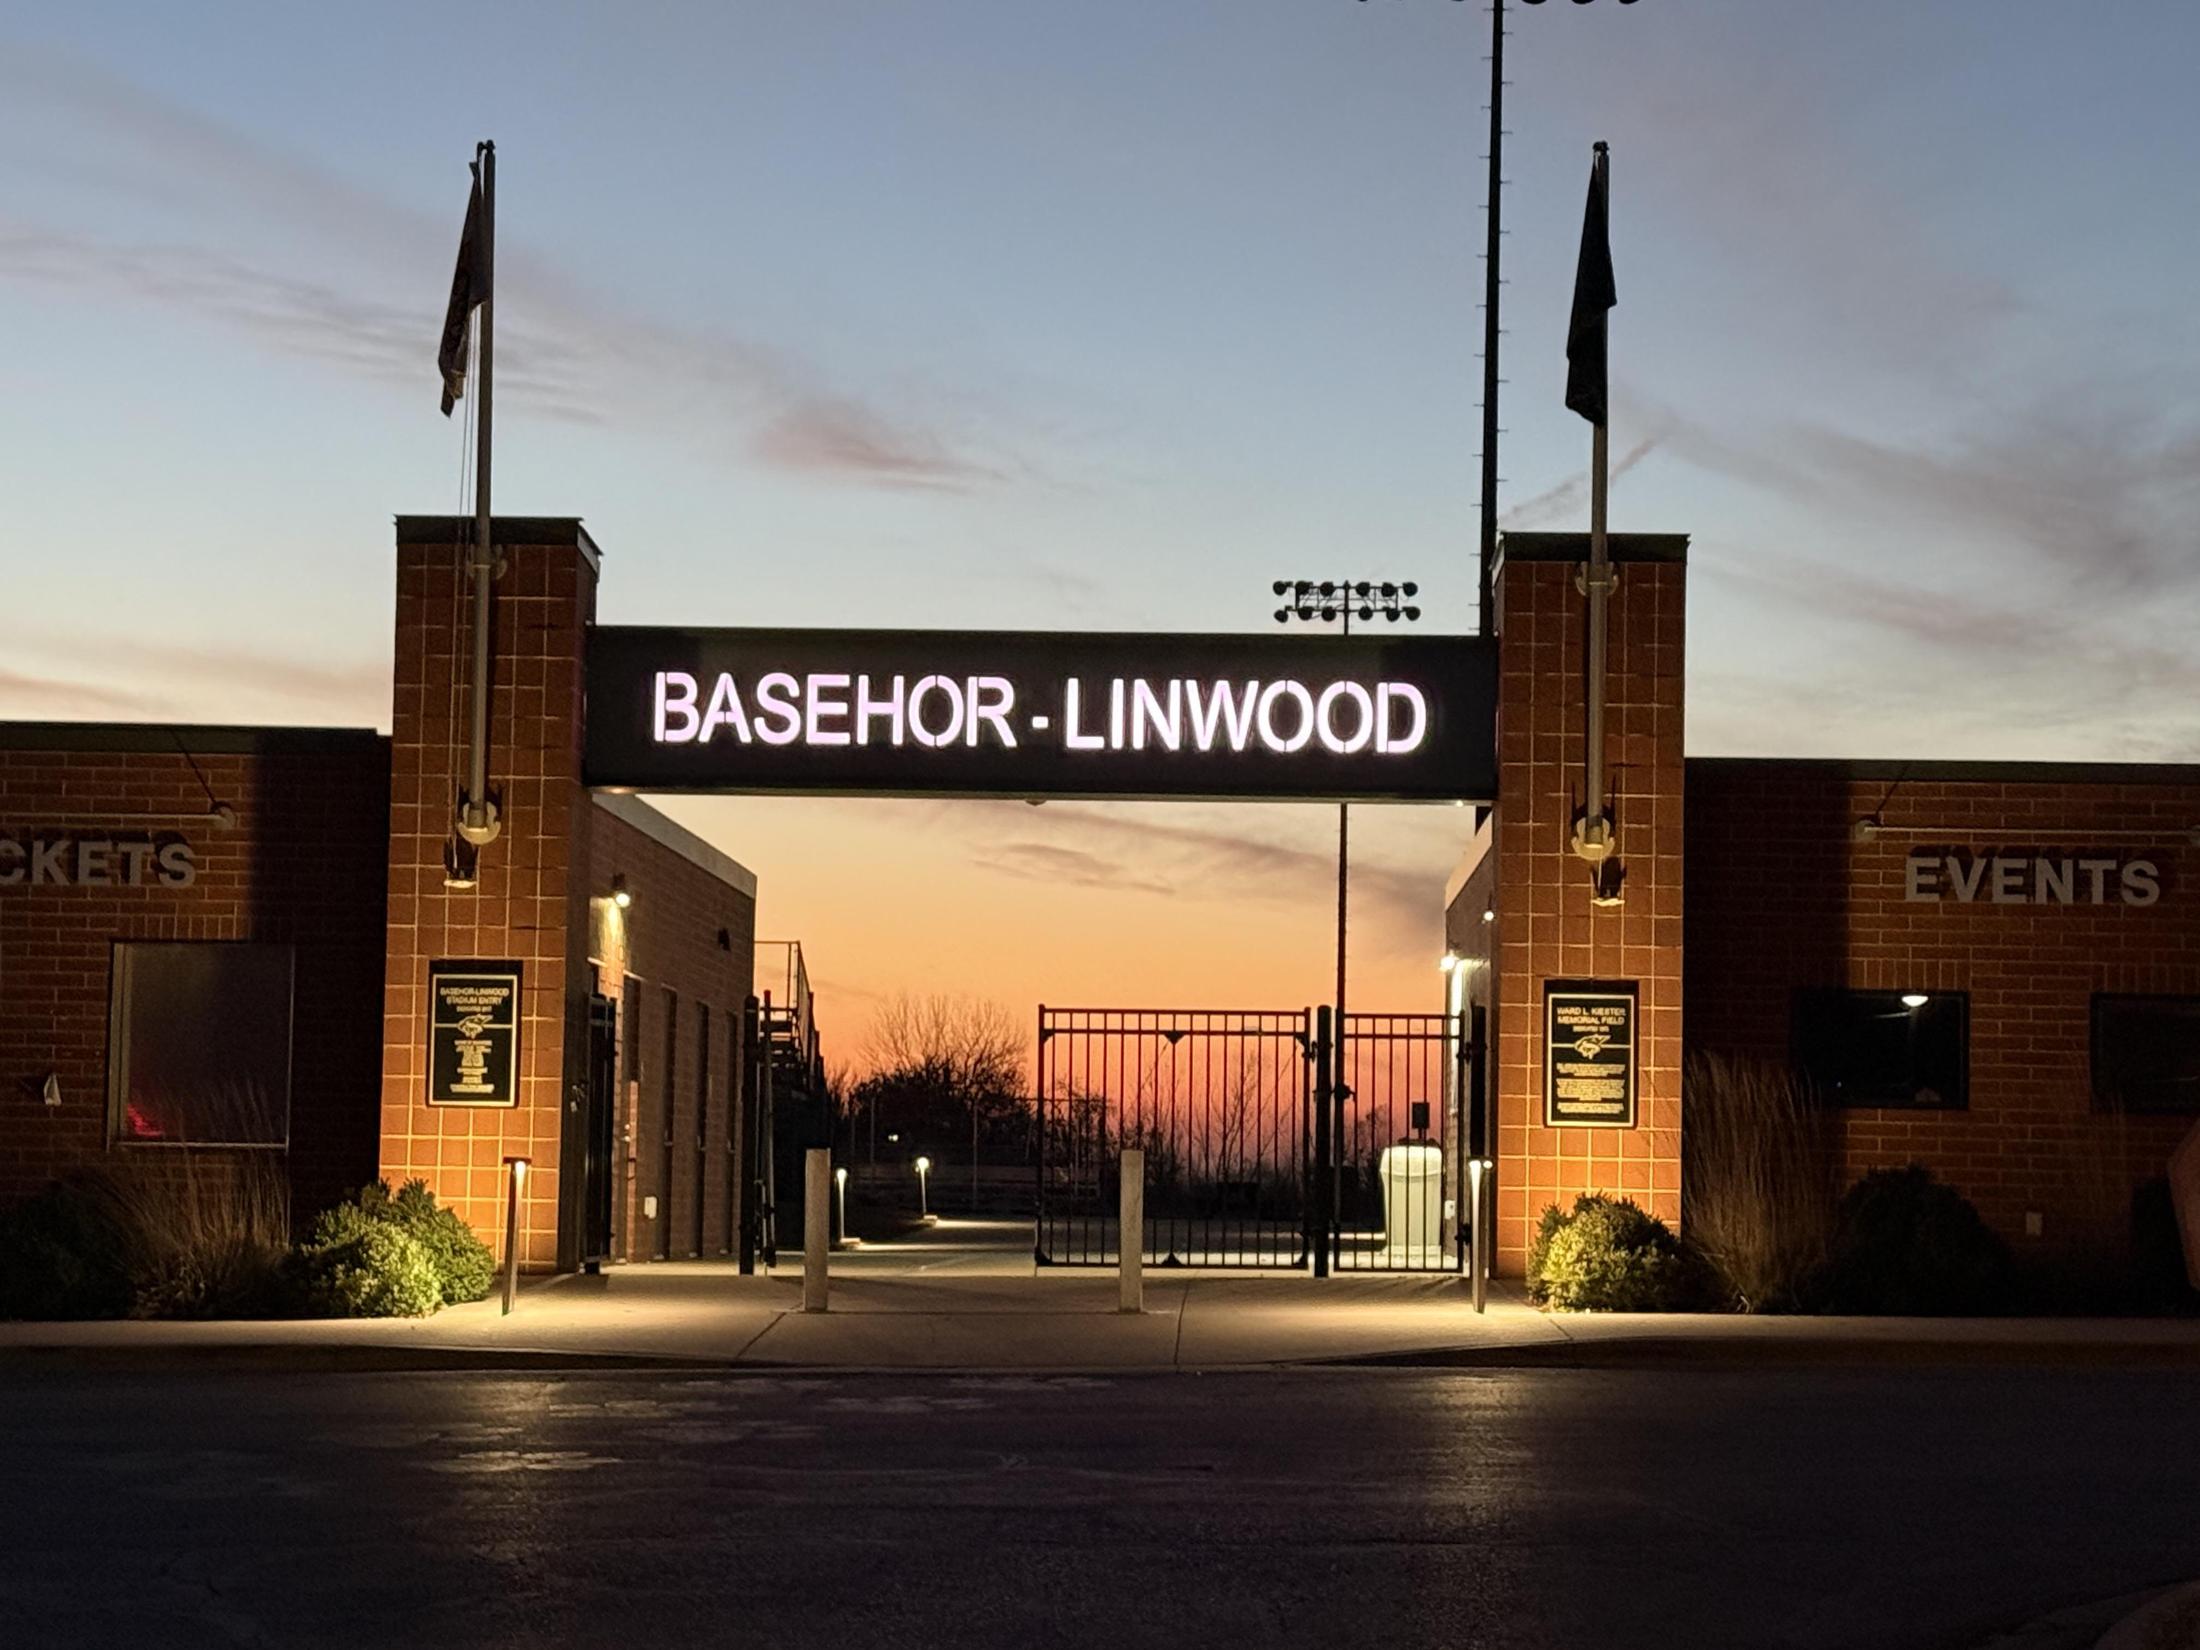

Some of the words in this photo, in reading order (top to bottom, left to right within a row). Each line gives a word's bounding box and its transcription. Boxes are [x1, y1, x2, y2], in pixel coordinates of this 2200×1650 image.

[653, 672, 1017, 748] BASEHOR
[1065, 678, 1427, 754] LINWOOD
[1905, 855, 2160, 907] EVENTS
